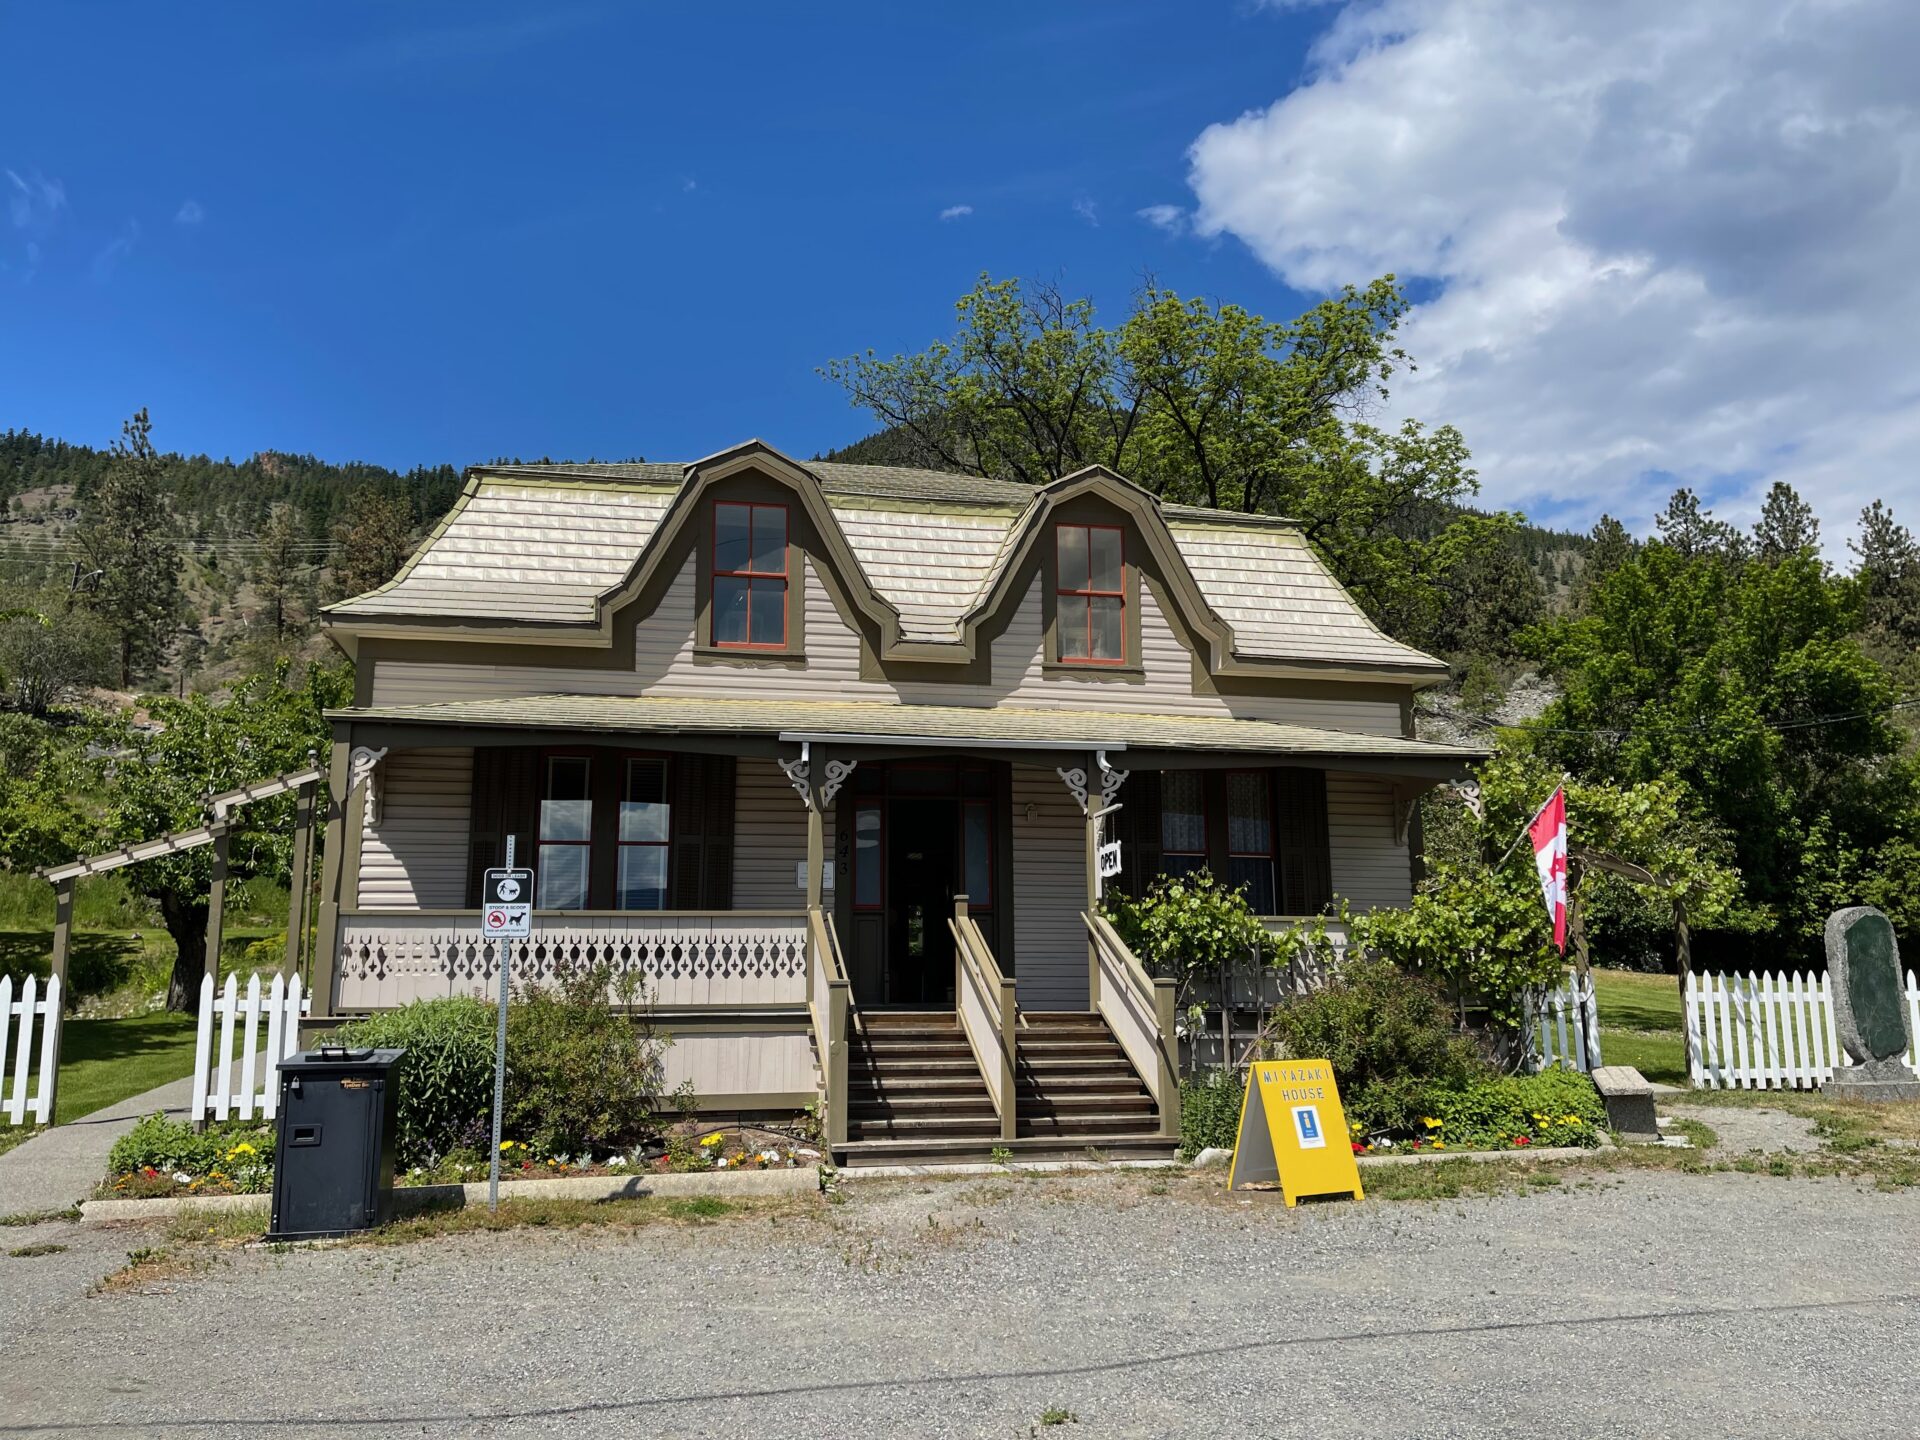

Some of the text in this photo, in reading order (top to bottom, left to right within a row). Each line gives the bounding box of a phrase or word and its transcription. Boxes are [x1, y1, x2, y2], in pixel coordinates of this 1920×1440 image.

[1101, 850, 1118, 872] OPEN
[1263, 1068, 1329, 1083] MIYAZAKI
[1282, 1087, 1325, 1101] HOUSE
